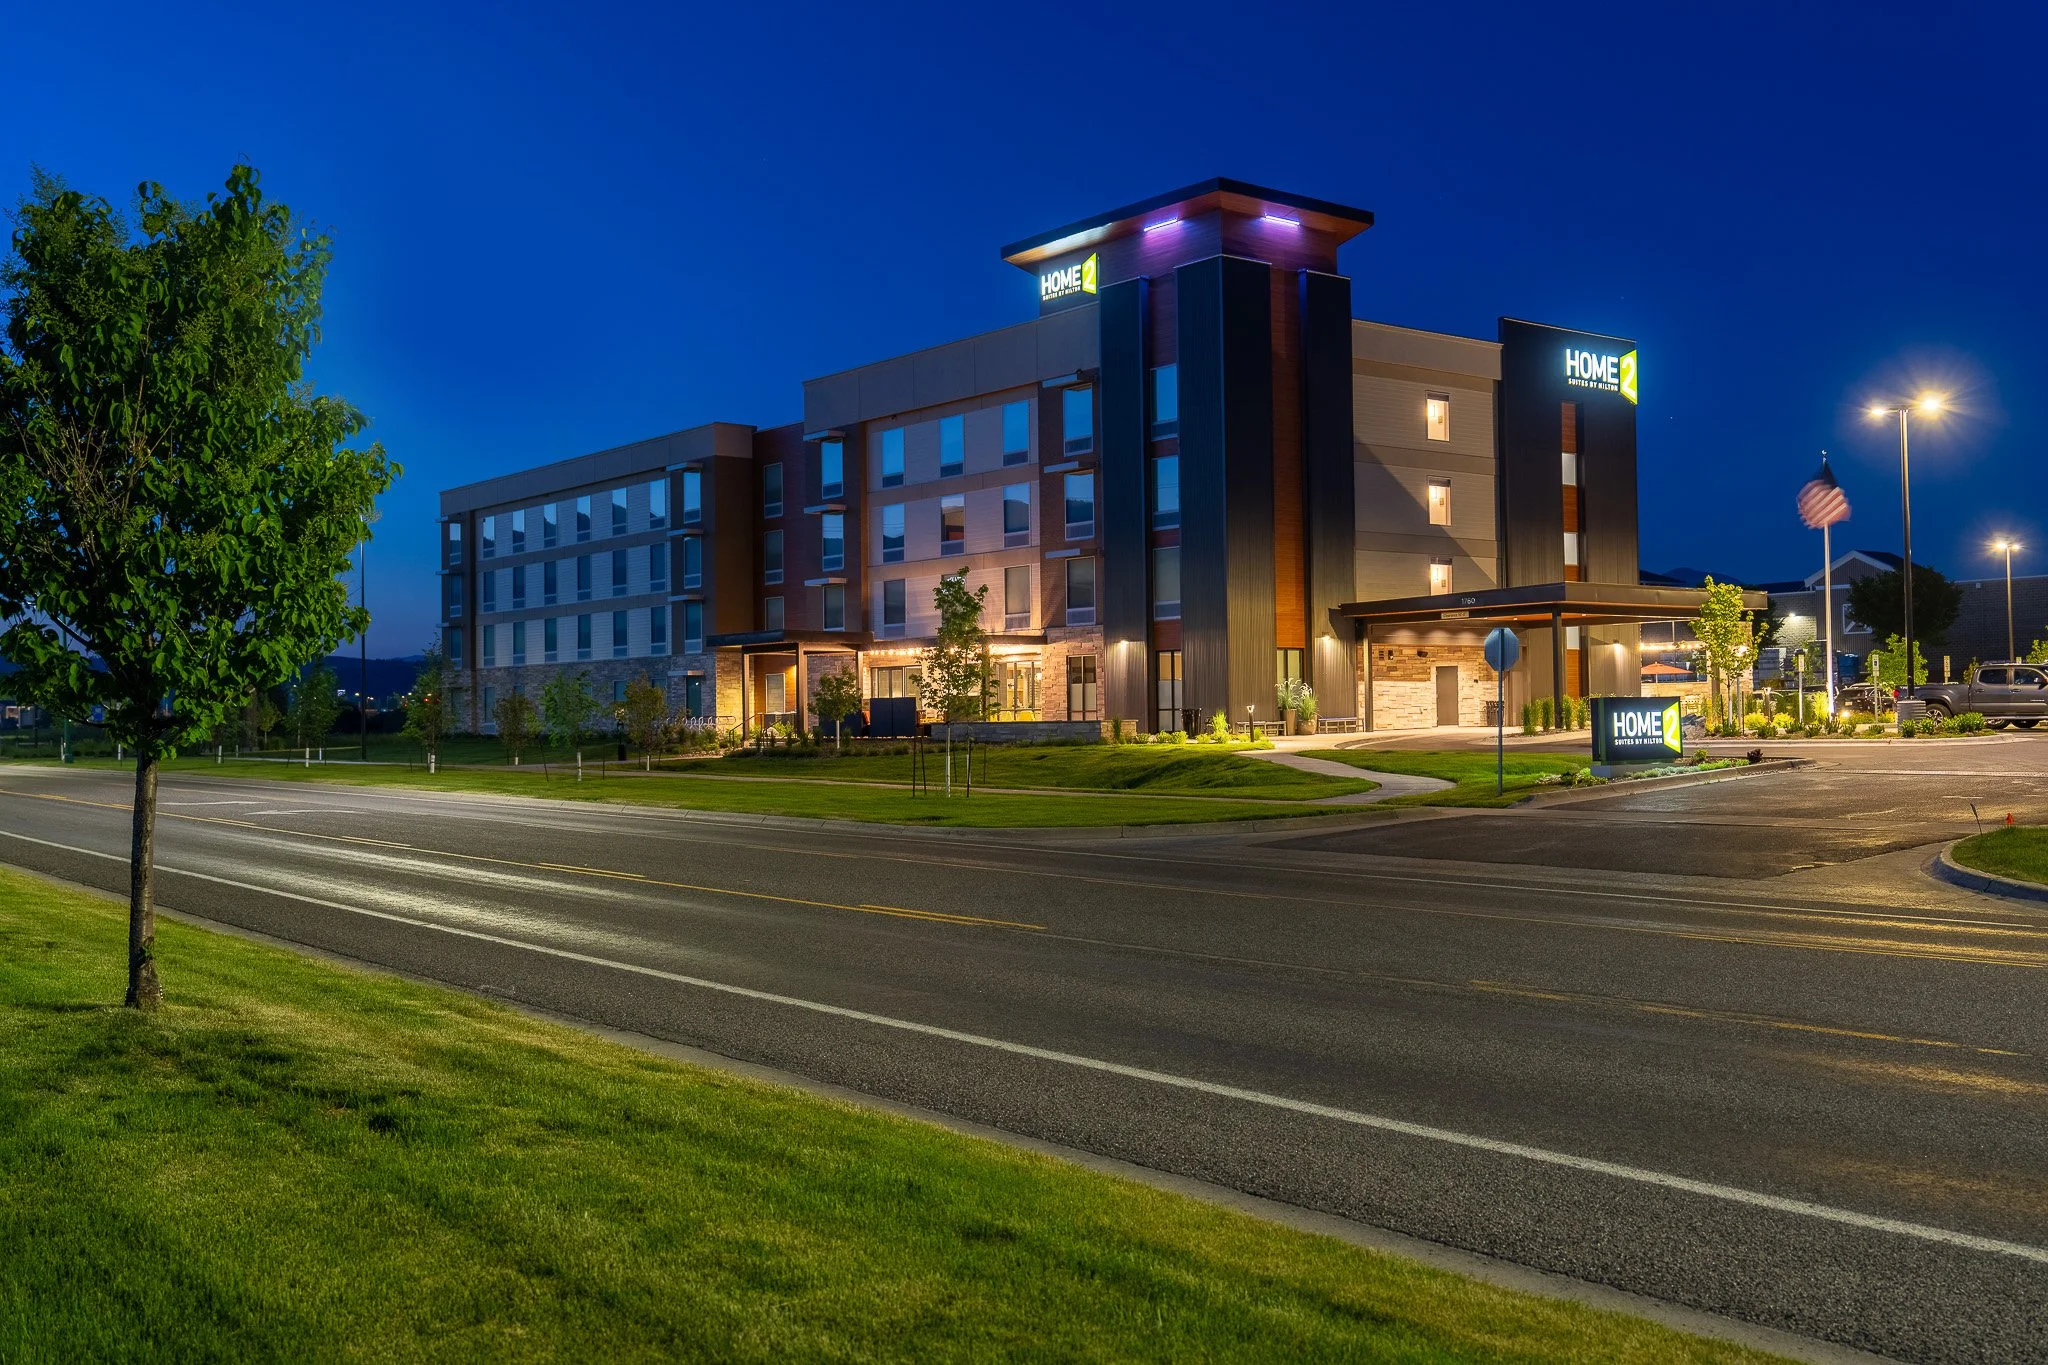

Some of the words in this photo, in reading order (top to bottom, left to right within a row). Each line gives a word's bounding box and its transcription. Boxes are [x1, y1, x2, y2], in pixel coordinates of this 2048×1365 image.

[1041, 265, 1081, 296] HOME
[1566, 348, 1619, 384] HOME
[1568, 377, 1589, 388] SUITES
[1589, 380, 1598, 389] BY
[1598, 382, 1619, 392] HILTON
[1461, 597, 1476, 605] 1760
[1613, 711, 1663, 738] HOME
[1614, 738, 1635, 746] SUITES
[1643, 737, 1664, 745] HILTON
